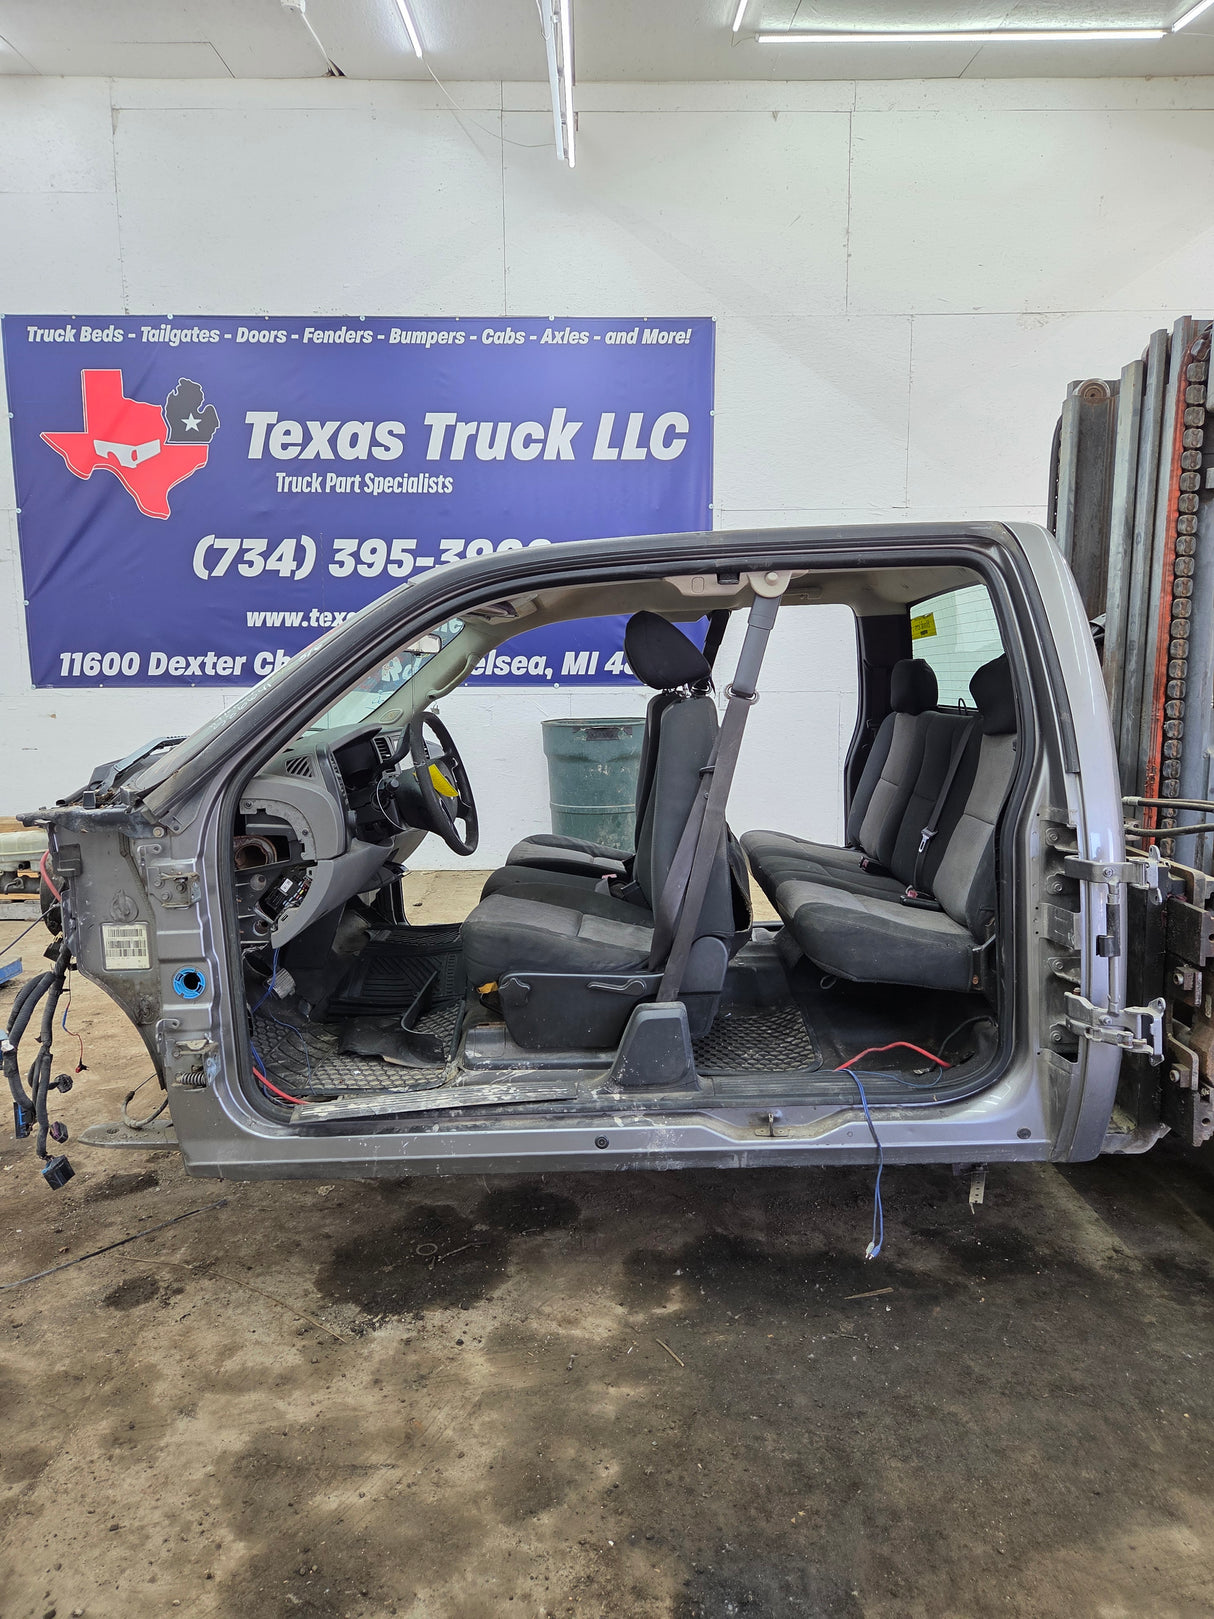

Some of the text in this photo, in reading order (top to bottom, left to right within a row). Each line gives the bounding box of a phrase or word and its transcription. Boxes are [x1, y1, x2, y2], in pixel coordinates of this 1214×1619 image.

[27, 324, 77, 343] Truck
[79, 324, 125, 343] Beds
[140, 324, 220, 347] Tailgates
[236, 326, 288, 344] Doors
[302, 326, 374, 344] Fenders
[389, 327, 466, 348] Bumpers
[481, 327, 526, 345] Cabs
[540, 327, 590, 345] Axles
[604, 328, 639, 345] and
[641, 328, 692, 345] More!
[244, 407, 690, 461] Texas Truck LLC
[275, 472, 454, 496] Truck Part Specialists
[192, 534, 317, 581] (734)
[59, 651, 141, 677] 11600
[147, 651, 247, 676] Dexter
[560, 651, 600, 675] MI
